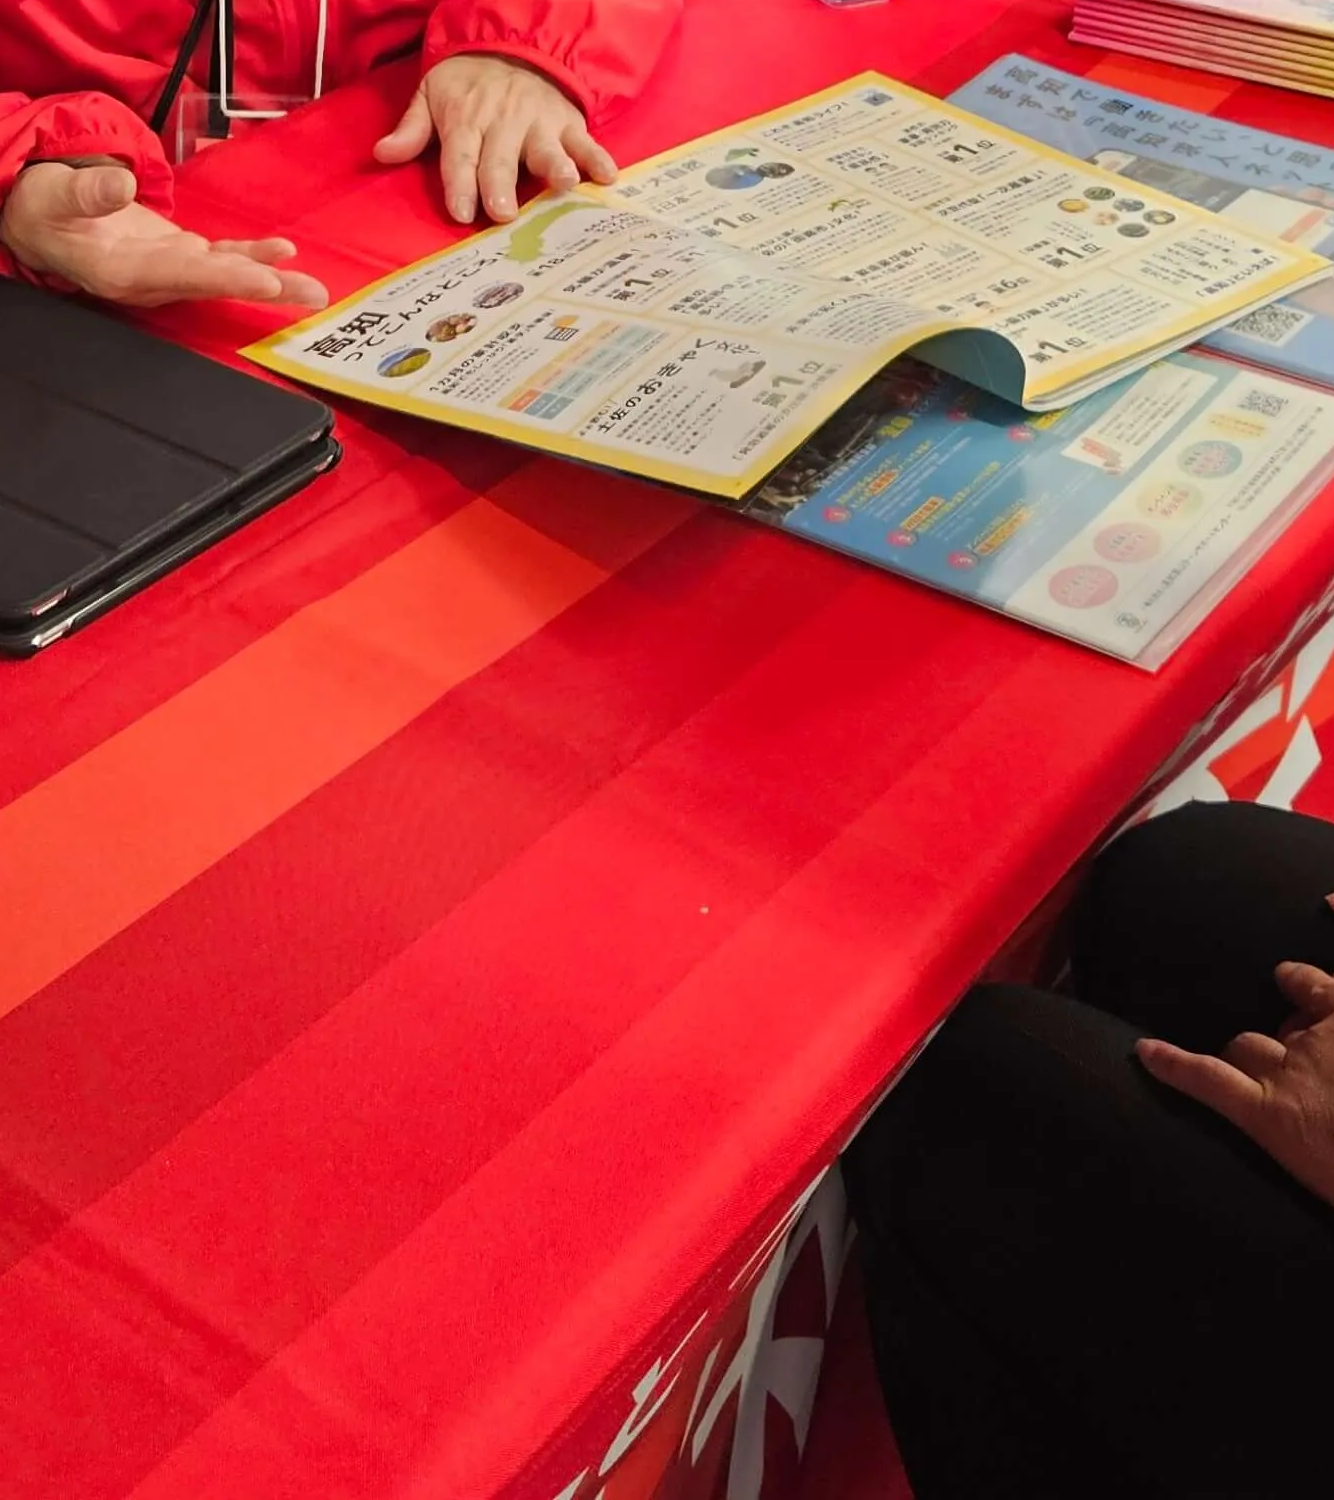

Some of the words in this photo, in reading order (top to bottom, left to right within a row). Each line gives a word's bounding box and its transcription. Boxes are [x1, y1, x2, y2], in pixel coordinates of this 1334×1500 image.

[941, 139, 997, 162] 第1位
[1042, 242, 1103, 269] 第1位
[338, 252, 507, 363] ってこんなところ!
[301, 311, 392, 357] 高知
[1026, 335, 1087, 363] 第1位
